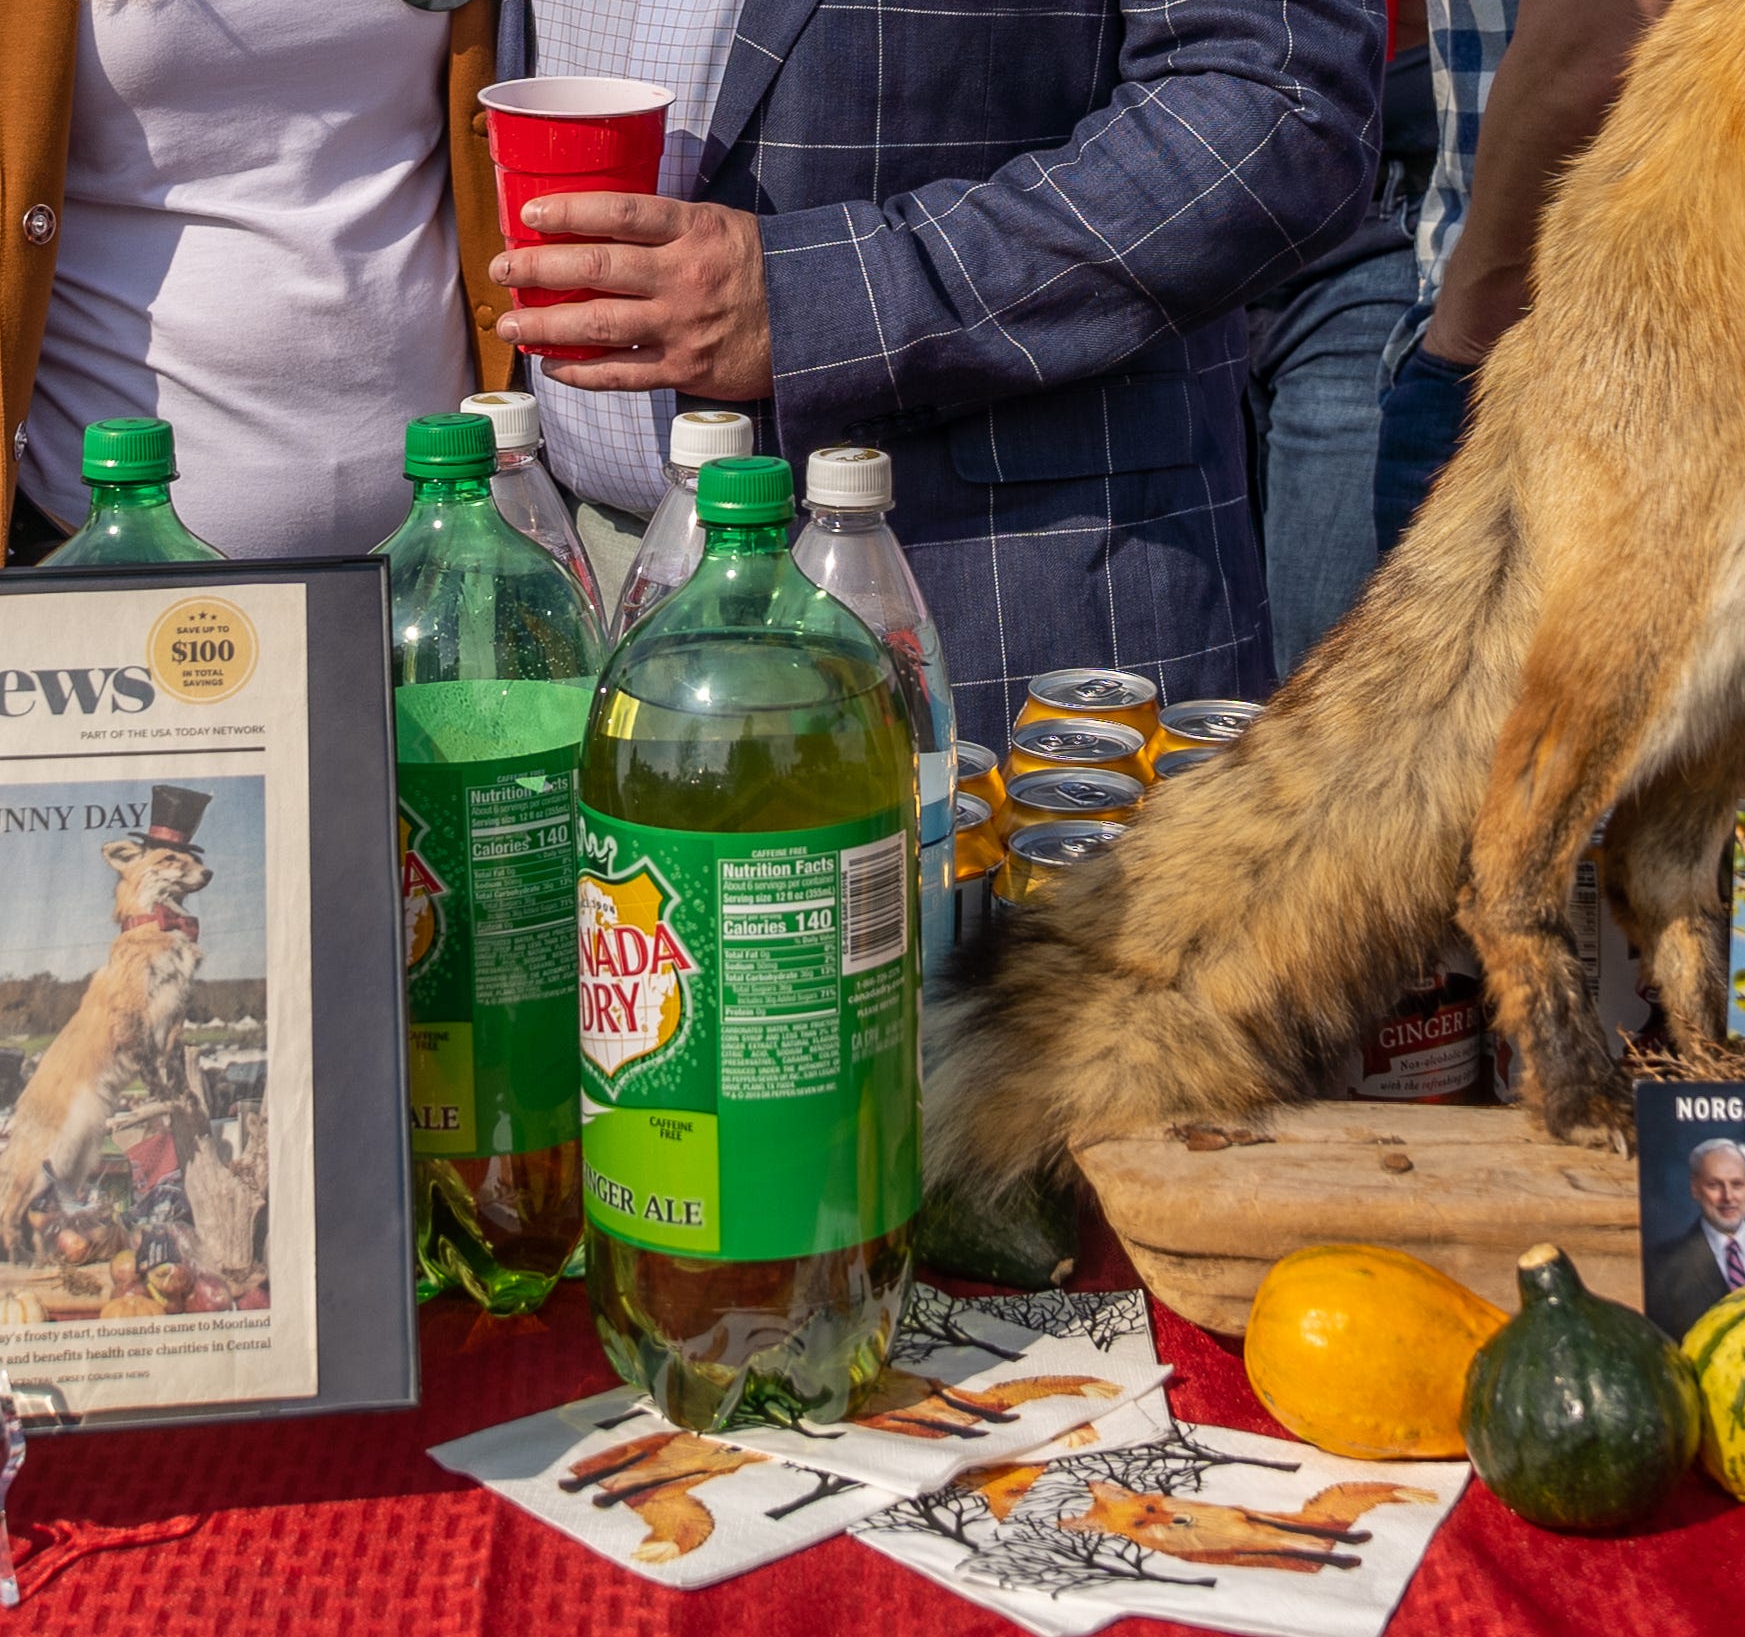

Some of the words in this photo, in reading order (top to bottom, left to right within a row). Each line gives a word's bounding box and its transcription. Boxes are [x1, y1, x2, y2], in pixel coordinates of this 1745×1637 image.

[176, 626, 200, 635] SAVE
[202, 626, 216, 634] UP
[217, 625, 230, 634] TO
[171, 638, 235, 665] $100
[182, 669, 193, 677] IN
[194, 668, 224, 677] TOTAL
[183, 678, 223, 687] SAVINGS
[81, 730, 107, 740] PART
[110, 730, 125, 739] OF
[126, 729, 148, 738] THE
[151, 728, 172, 737] USA
[174, 726, 209, 736] TODAY
[212, 725, 266, 735] NETWORK
[470, 787, 531, 804] Nutrition
[84, 802, 148, 830] DAY
[472, 839, 529, 858] Calories
[537, 825, 569, 847] 140
[751, 848, 787, 859] CAFFEINE
[789, 846, 808, 856] FREE
[723, 861, 791, 878] Nutrition
[795, 857, 834, 875] Facts
[723, 880, 746, 891] About
[747, 880, 753, 890] 6
[754, 878, 787, 891] servings
[788, 878, 800, 888] per
[802, 875, 834, 886] container
[723, 893, 754, 905] Serving
[755, 891, 772, 903] size
[775, 891, 785, 902] 12
[787, 890, 793, 901] fl
[794, 892, 804, 901] oz
[805, 886, 835, 900] (355mL)
[723, 919, 786, 935] Calories
[795, 909, 832, 931] 140
[725, 949, 744, 960] Total
[746, 948, 758, 959] Fat
[725, 972, 746, 983] Total
[747, 970, 798, 983] Carbohydrate
[581, 982, 639, 1033] DRY
[1379, 1011, 1463, 1048] GINGER
[1380, 1079, 1401, 1091] with
[1404, 1079, 1419, 1090] the
[649, 1116, 694, 1133] CAFFEINE
[659, 1128, 683, 1141] FREE
[644, 1195, 703, 1226] ALE
[24, 1328, 58, 1344] frosty
[63, 1327, 94, 1340] start,
[97, 1323, 160, 1338] thousands
[163, 1323, 195, 1335] came
[199, 1321, 210, 1332] to
[212, 1316, 271, 1331] Moorland
[7, 1352, 30, 1365] and
[33, 1349, 83, 1363] benefits
[86, 1347, 125, 1360] health
[128, 1346, 153, 1358] care
[156, 1342, 208, 1356] charities
[212, 1341, 224, 1352] in
[227, 1337, 271, 1352] Central
